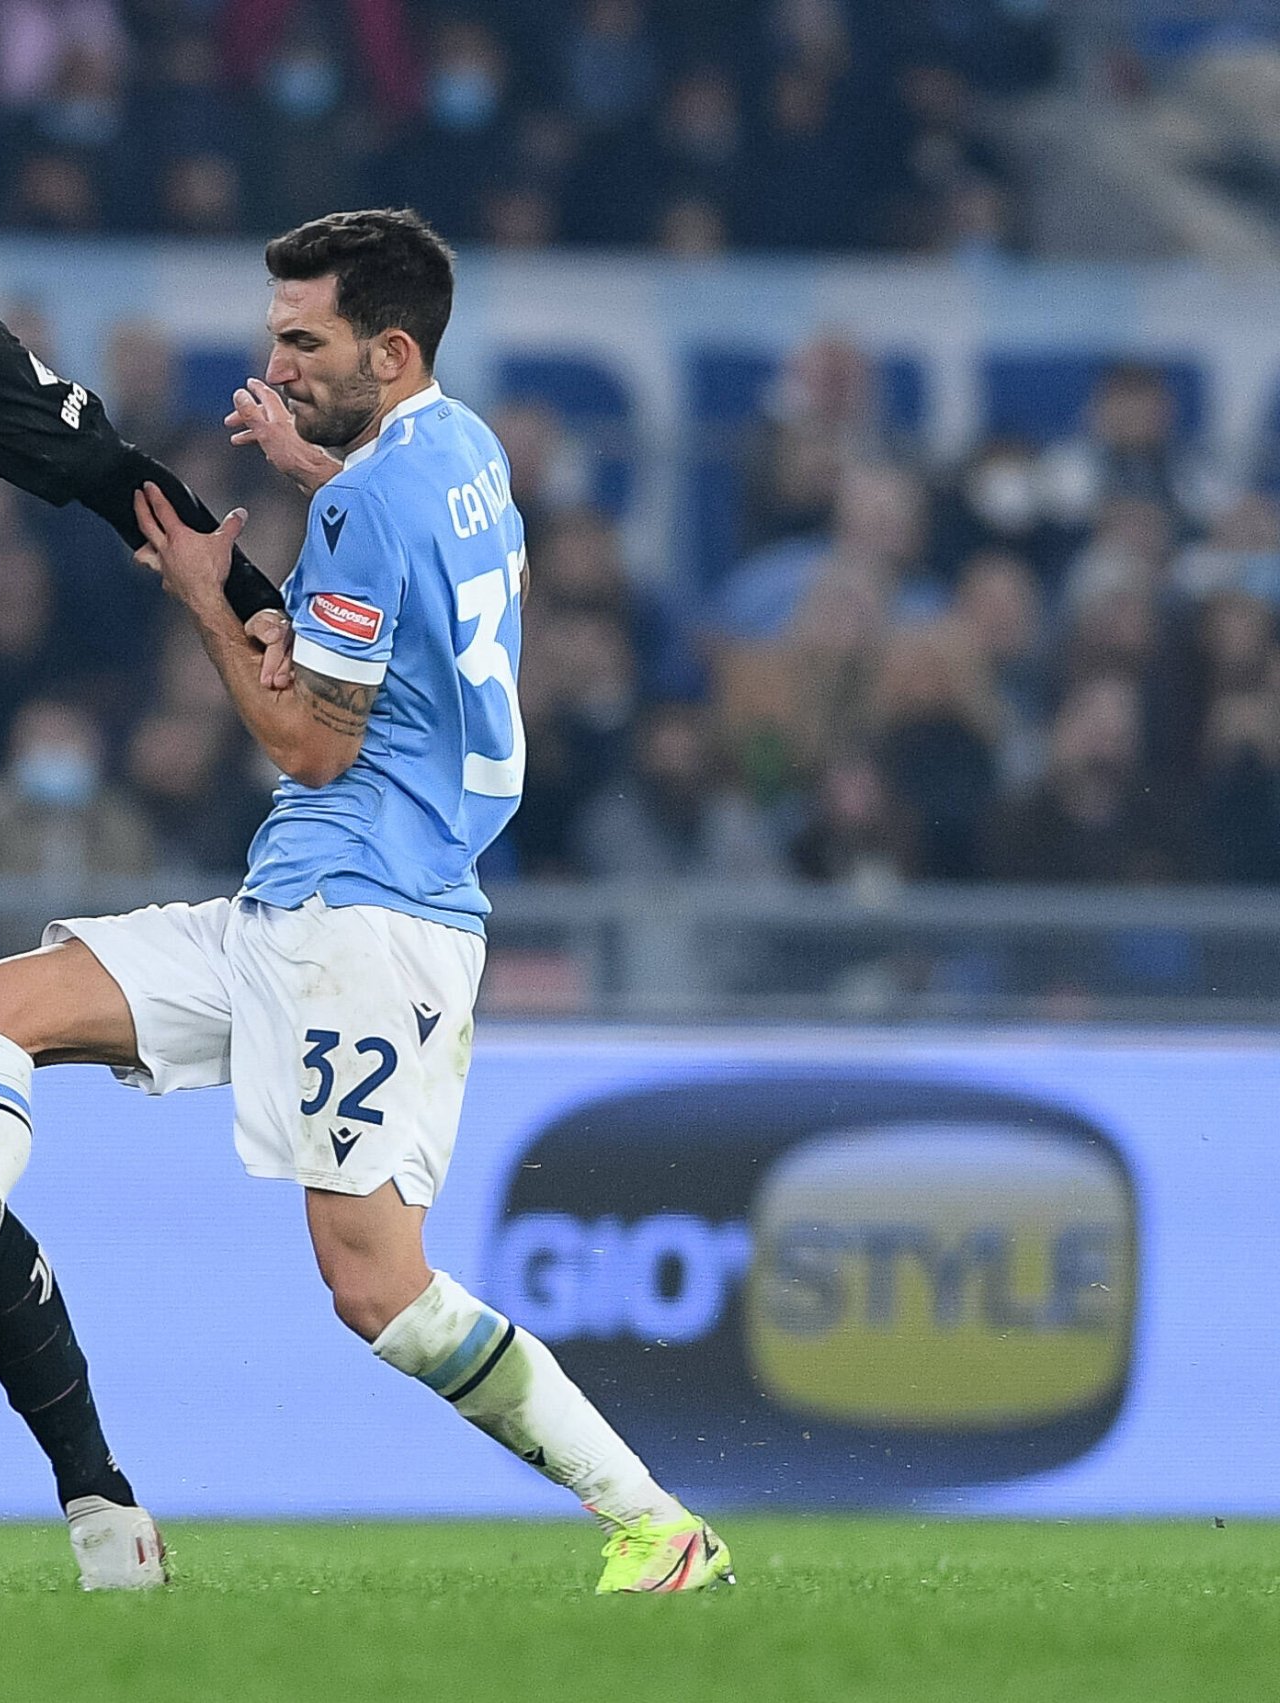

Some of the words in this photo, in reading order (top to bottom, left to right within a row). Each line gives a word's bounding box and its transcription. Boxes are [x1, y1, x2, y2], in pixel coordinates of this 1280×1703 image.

[61, 382, 87, 429] Bitg
[457, 550, 526, 798] 3
[300, 1029, 396, 1126] 32
